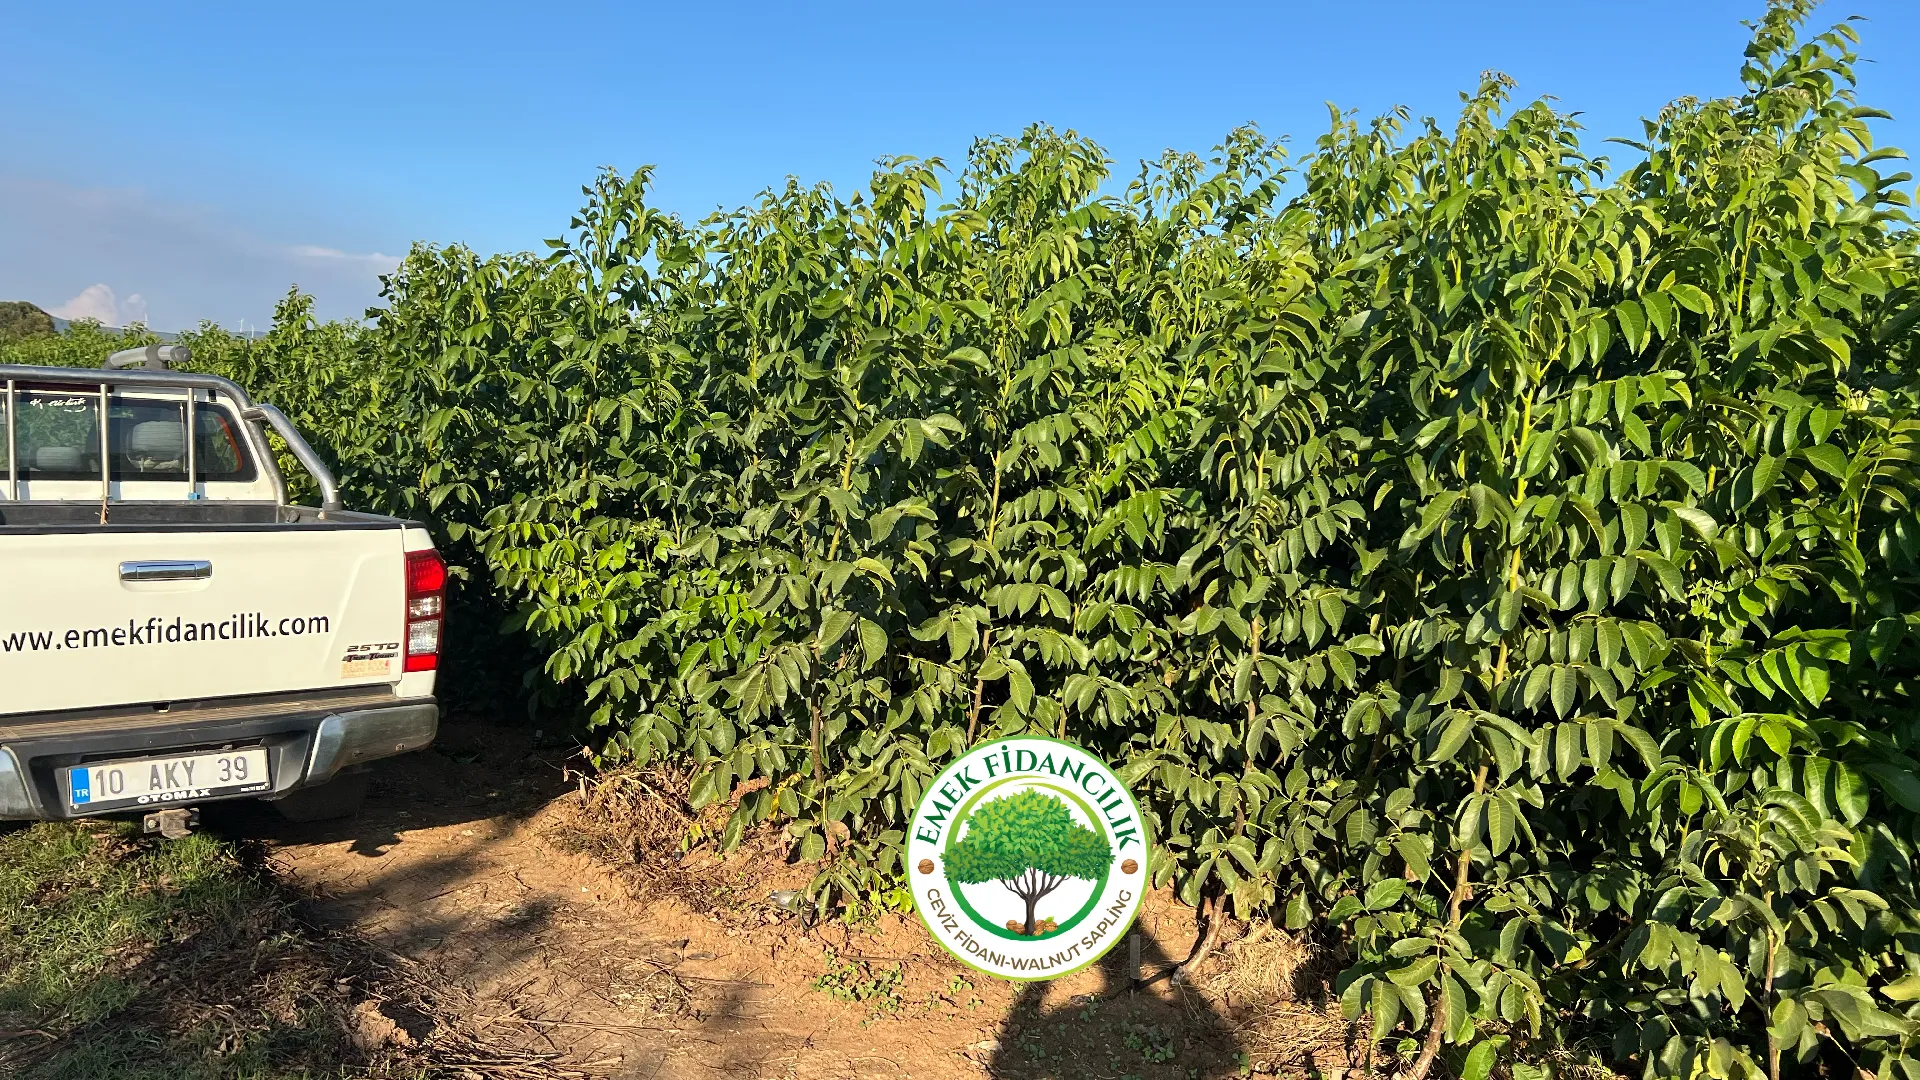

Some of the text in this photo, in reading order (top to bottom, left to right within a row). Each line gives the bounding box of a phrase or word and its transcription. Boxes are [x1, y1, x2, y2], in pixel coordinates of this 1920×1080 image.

[95, 756, 249, 797] 10 AKY 39
[74, 788, 89, 798] TR
[137, 788, 211, 805] OTOMAX
